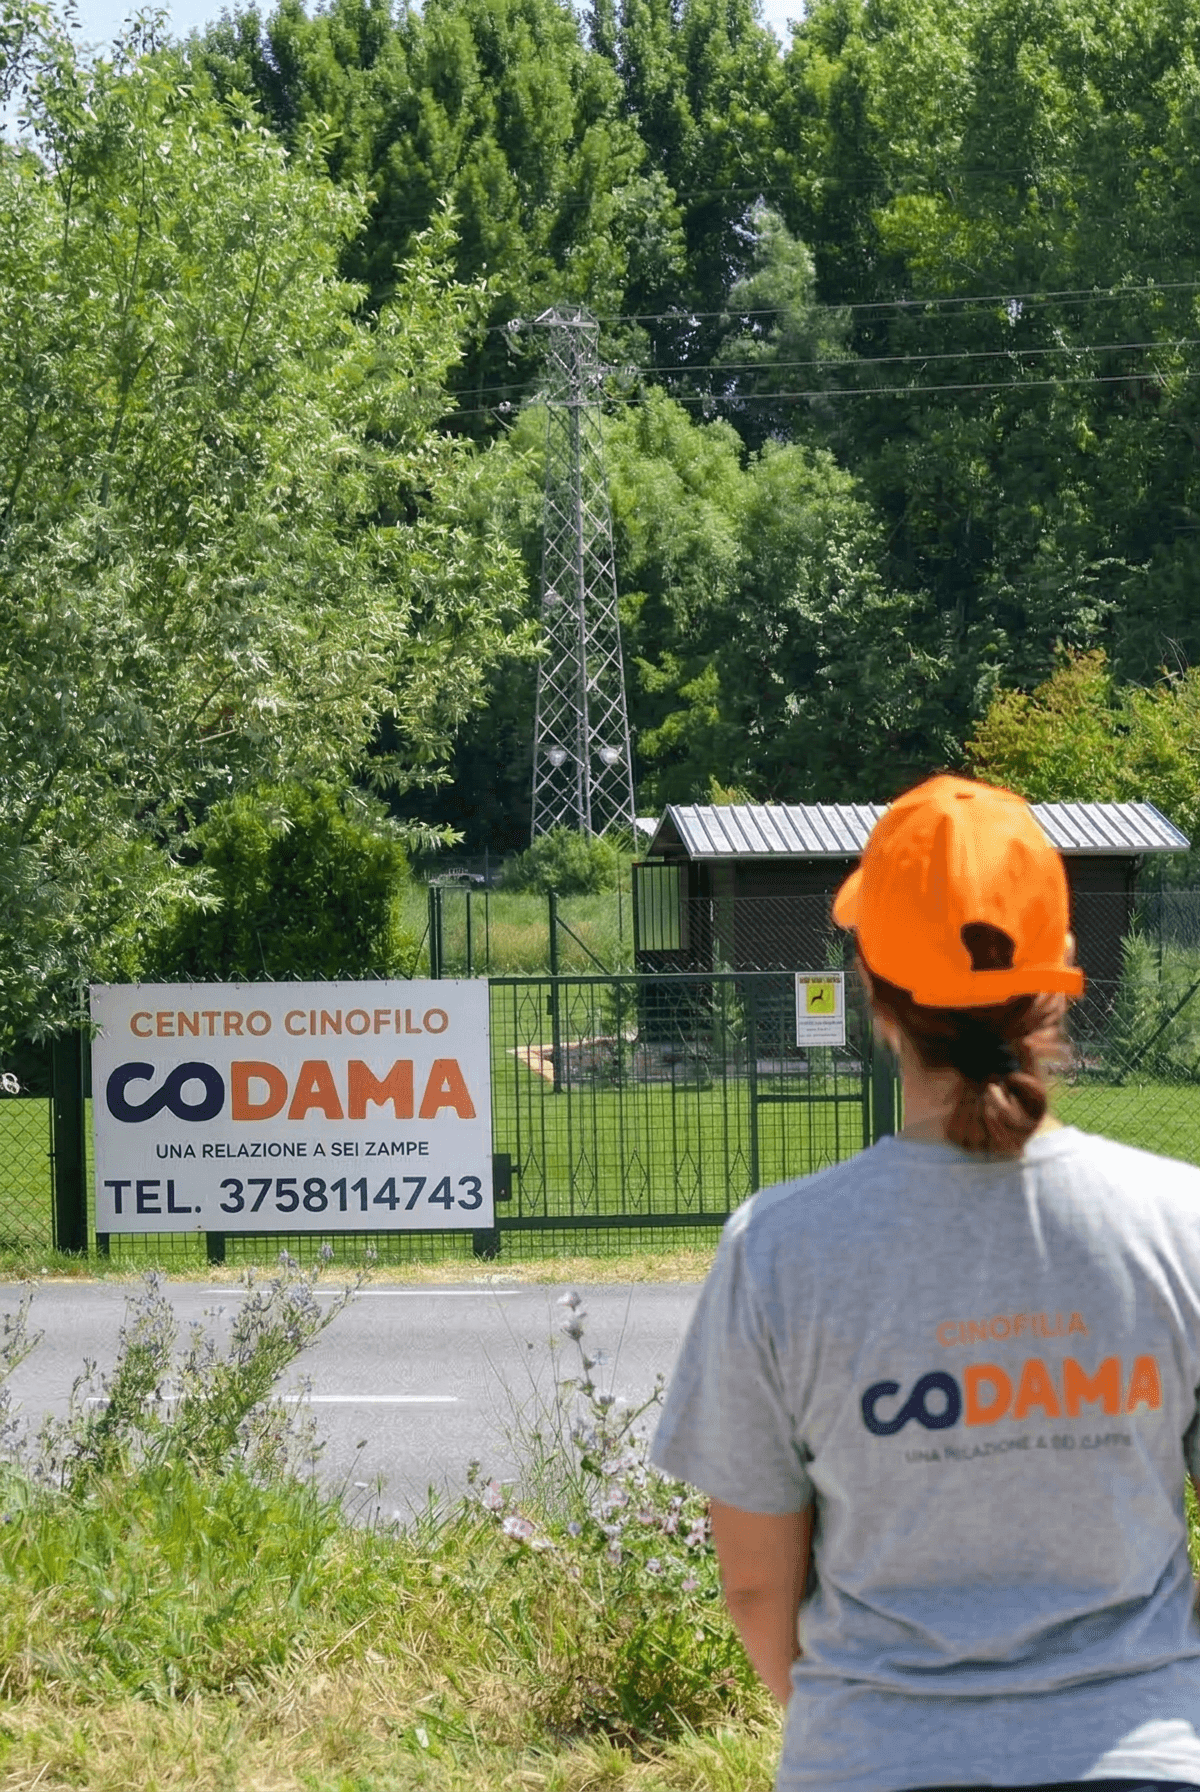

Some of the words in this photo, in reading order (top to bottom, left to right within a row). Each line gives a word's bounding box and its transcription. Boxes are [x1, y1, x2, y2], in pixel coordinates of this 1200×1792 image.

[130, 1010, 272, 1037] CENTRO
[284, 1008, 450, 1036] CINOFILO
[106, 1059, 477, 1123] CODAMA
[156, 1143, 196, 1160] UNA
[202, 1142, 307, 1158] RELAZIONE
[313, 1142, 326, 1157] A
[331, 1142, 359, 1157] SEI
[365, 1141, 429, 1156] ZAMPE
[104, 1179, 202, 1214] TEL.
[219, 1175, 483, 1213] 3758114743
[936, 1311, 1089, 1347] CINOFILIA
[861, 1355, 1162, 1437] CODAMA
